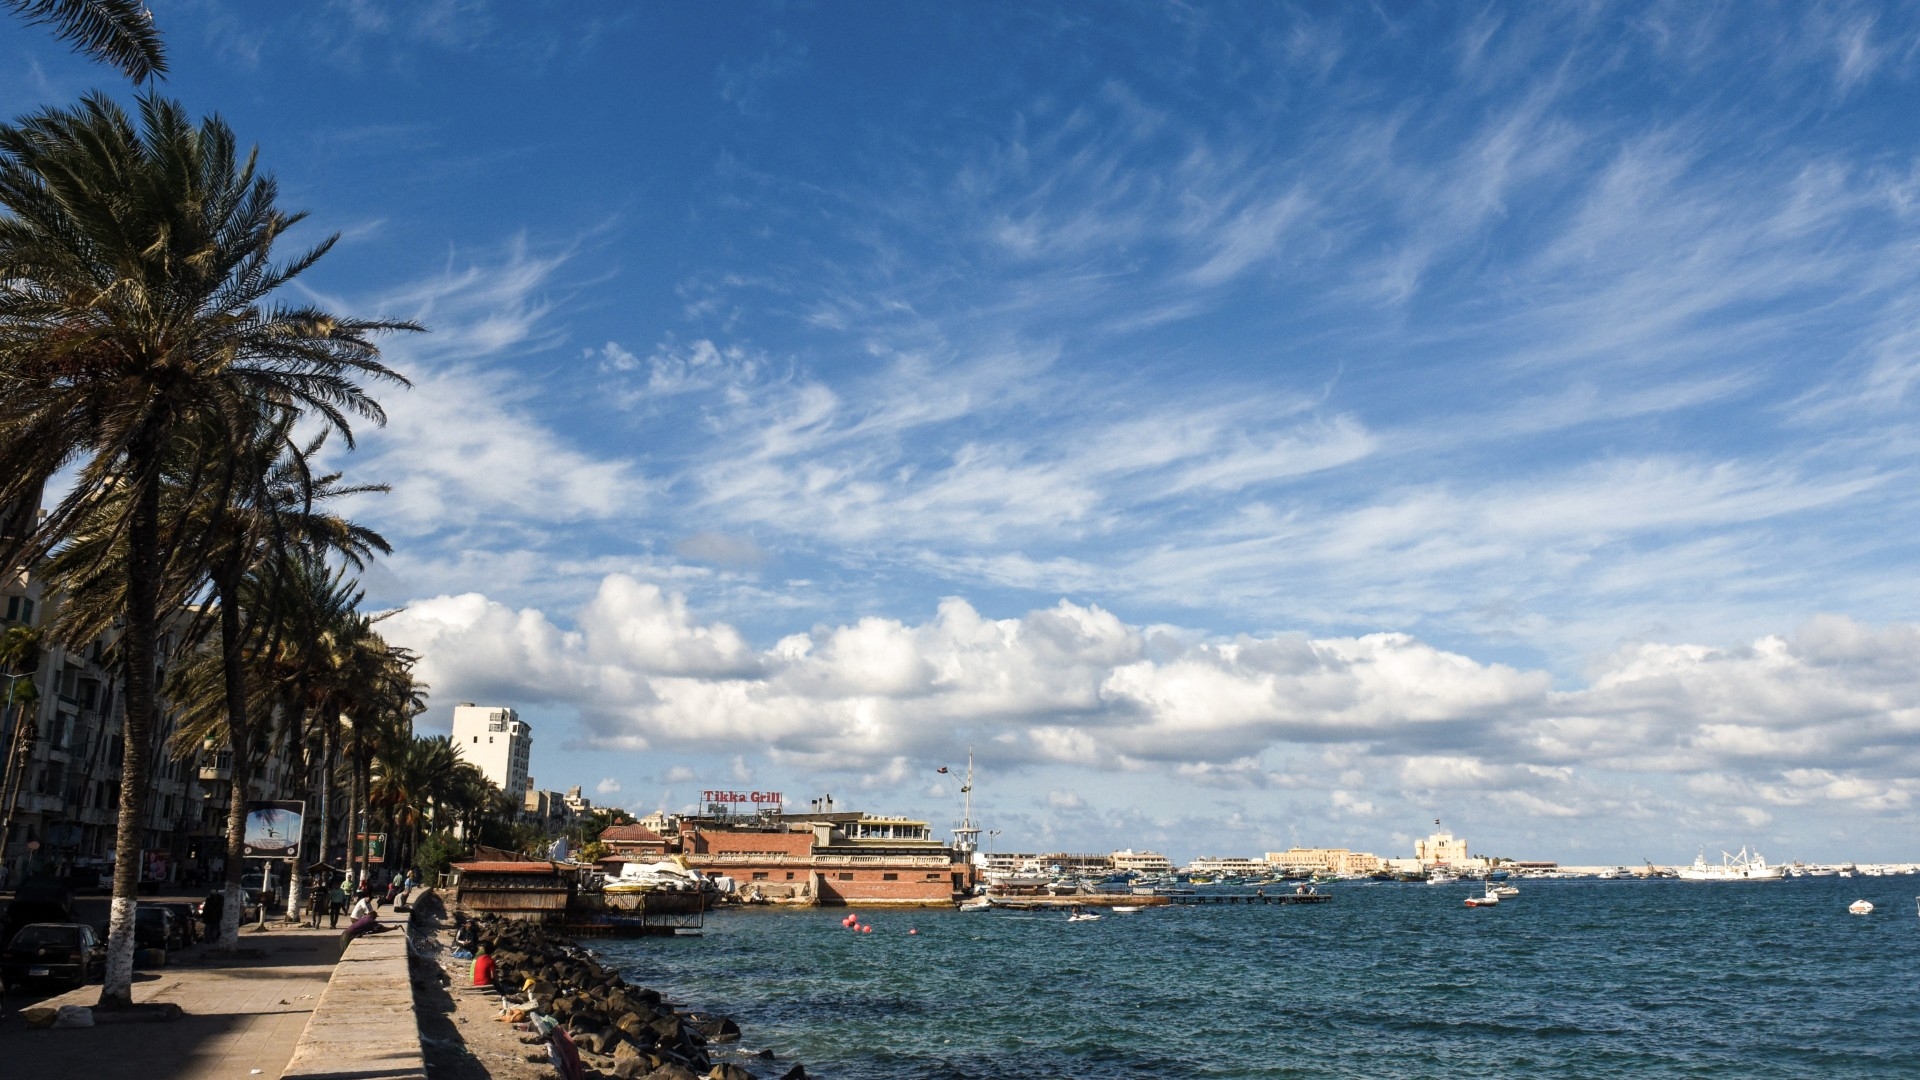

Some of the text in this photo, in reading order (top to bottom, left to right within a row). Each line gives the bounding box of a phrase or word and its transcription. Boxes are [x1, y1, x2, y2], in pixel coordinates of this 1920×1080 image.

[704, 791, 780, 803] Tikka Grill
[715, 814, 758, 825] Market
